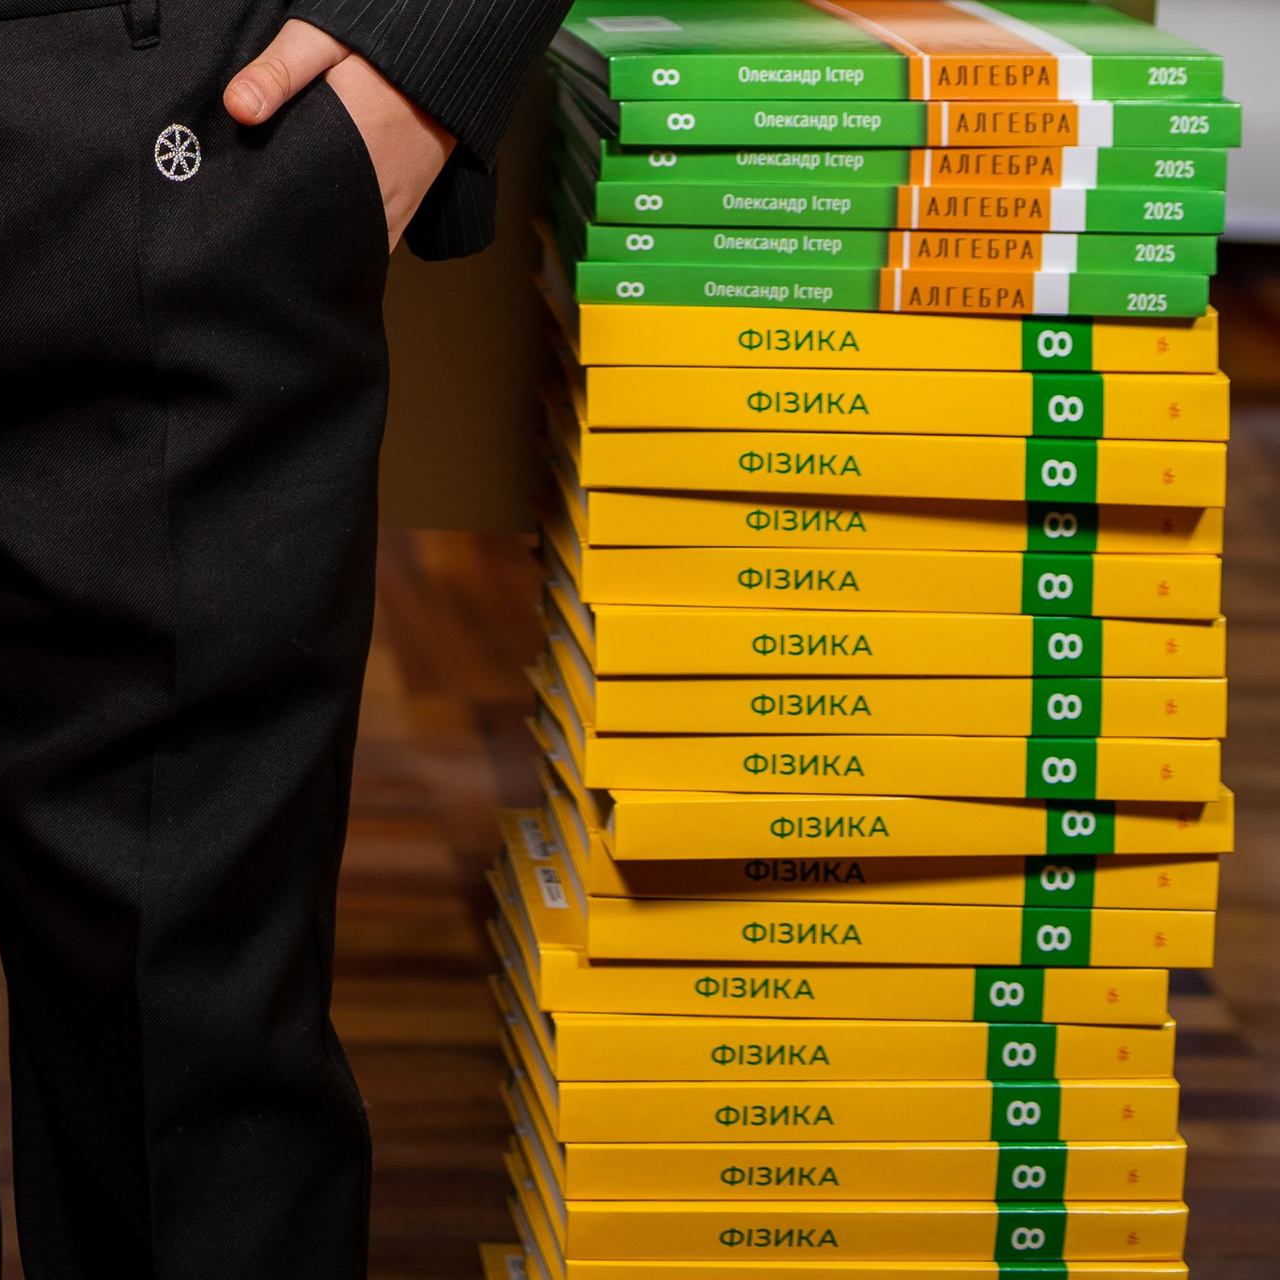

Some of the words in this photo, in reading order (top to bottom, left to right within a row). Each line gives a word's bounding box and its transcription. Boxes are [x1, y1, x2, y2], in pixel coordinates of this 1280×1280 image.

[652, 68, 680, 86] 8
[739, 66, 820, 86] Олександр
[825, 66, 863, 86] Істер
[938, 65, 1049, 86] АЛГЕБРА
[1150, 67, 1187, 85] 2025
[667, 113, 695, 130] 8
[755, 111, 837, 132] Олександр
[842, 112, 881, 131] Істер
[957, 113, 1069, 133] АЛГЕБРА
[1171, 115, 1209, 134] 2025
[737, 150, 820, 171] Олександр
[825, 152, 863, 171] Істер
[939, 154, 1053, 175] АЛГЕБРА
[1156, 160, 1194, 178] 2025
[635, 194, 663, 210] 8
[723, 193, 806, 214] Олександр
[812, 195, 850, 215] Істер
[927, 197, 1042, 218] АЛГЕБРА
[1145, 202, 1184, 220] 2025
[626, 234, 654, 250] 8
[714, 233, 797, 254] Олександр
[803, 235, 842, 255] Істер
[918, 238, 1033, 259] АЛГЕБРА
[1137, 244, 1175, 262] 2025
[617, 281, 644, 297] 8
[705, 281, 788, 302] Олександр
[794, 284, 832, 303] Істер
[909, 286, 1024, 308] АЛГЕБРА
[1129, 293, 1167, 311] 2025
[739, 329, 859, 351] ФІЗИКА
[1038, 330, 1072, 357] 8
[748, 391, 868, 414] ФІЗИКА
[1049, 395, 1083, 422] 8
[739, 451, 861, 476] ФІЗИКА
[1042, 460, 1077, 486] 8
[746, 508, 867, 533] ФІЗИКА
[738, 568, 859, 591] ФІЗИКА
[1038, 573, 1073, 599] 8
[752, 634, 872, 656] ФІЗИКА
[1049, 633, 1082, 659] 8
[751, 694, 871, 716] ФІЗИКА
[1048, 694, 1082, 720] 8
[744, 753, 864, 776] ФІЗИКА
[1042, 757, 1077, 783] 8
[771, 816, 888, 839] ФІЗИКА
[1062, 811, 1095, 836] 8
[742, 922, 861, 945] ФІЗИКА
[1037, 925, 1071, 951] 8
[695, 976, 814, 1000] ФІЗИКА
[990, 981, 1024, 1006] 8
[712, 1044, 829, 1065] ФІЗИКА
[1002, 1042, 1036, 1067] 8
[716, 1105, 834, 1126] ФІЗИКА
[1007, 1101, 1040, 1125] 8
[721, 1166, 839, 1186] ФІЗИКА
[1013, 1165, 1046, 1188] 8
[720, 1228, 838, 1247] ФІЗИКА
[1012, 1227, 1045, 1250] 8
